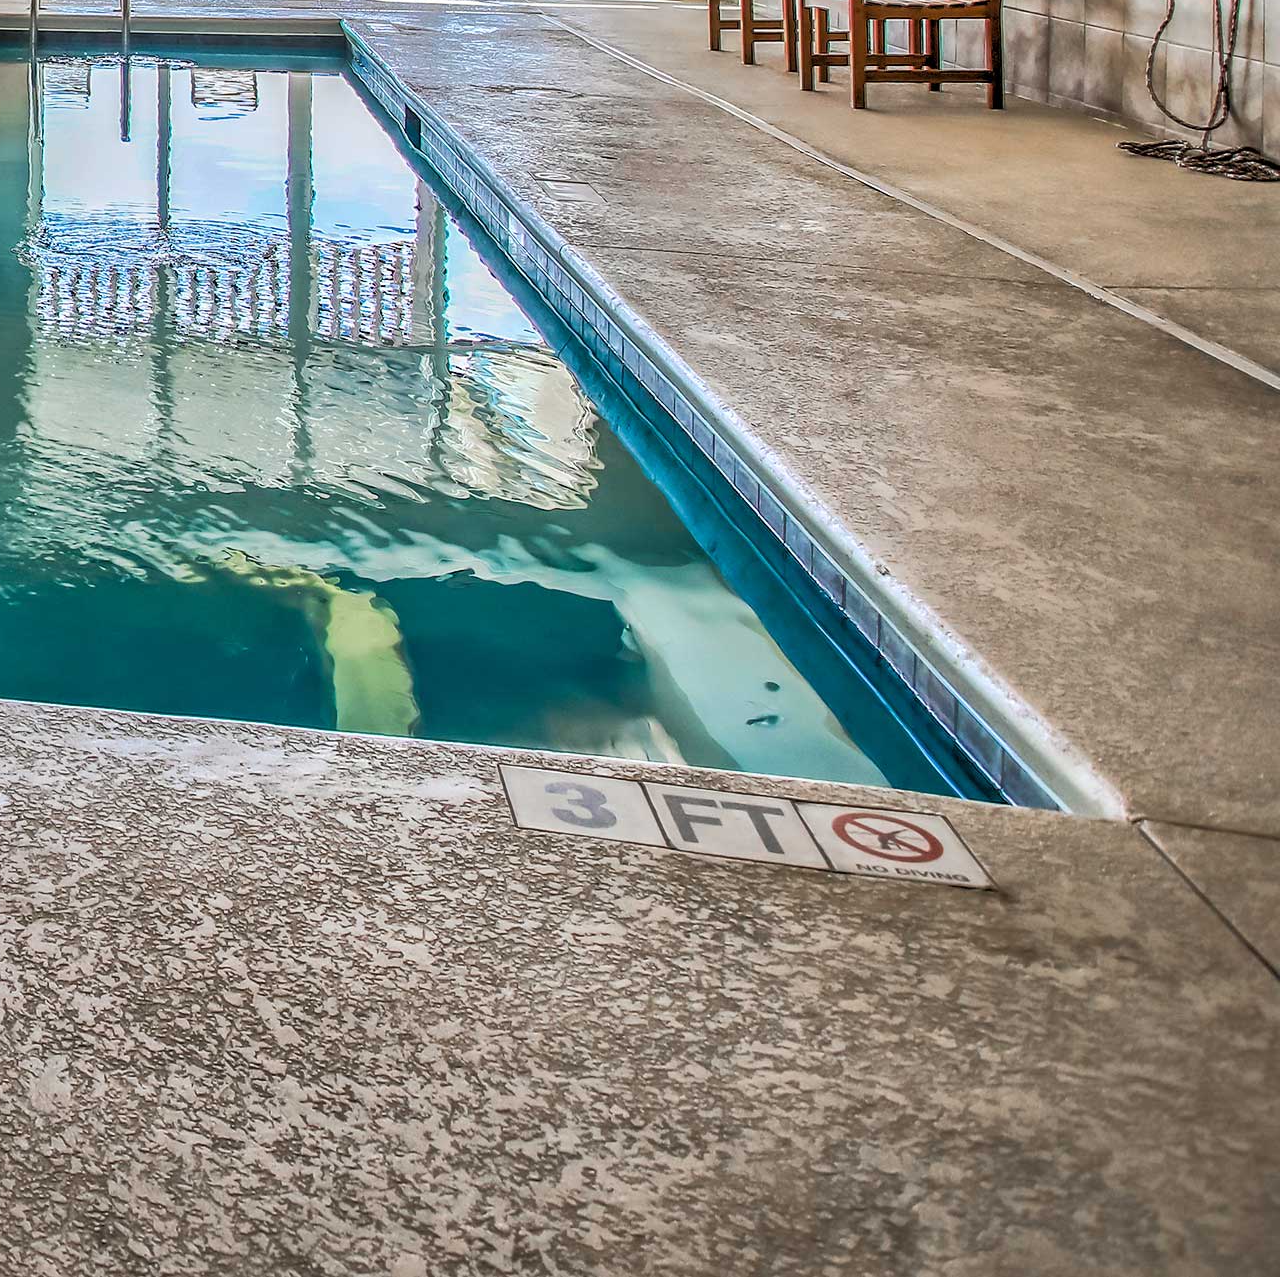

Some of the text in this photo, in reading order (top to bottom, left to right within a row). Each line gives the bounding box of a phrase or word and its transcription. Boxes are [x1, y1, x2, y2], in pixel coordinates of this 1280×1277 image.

[545, 781, 786, 855] 3 FT
[855, 863, 971, 883] NO DIVING
